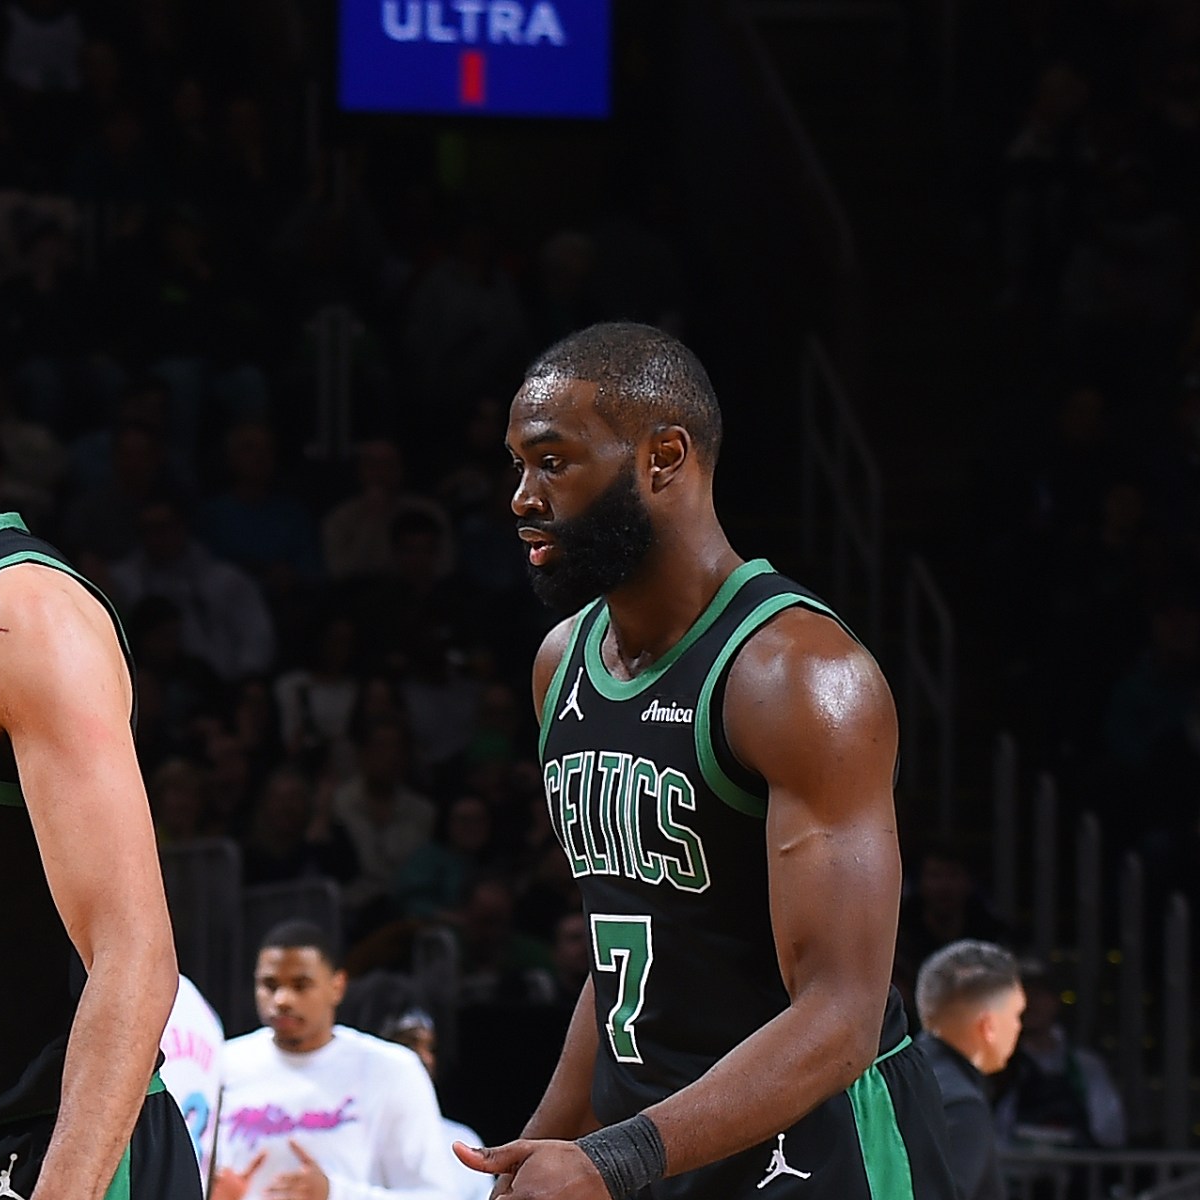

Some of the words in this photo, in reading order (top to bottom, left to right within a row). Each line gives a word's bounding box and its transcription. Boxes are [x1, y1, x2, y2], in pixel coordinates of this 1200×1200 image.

[381, 0, 566, 45] ULTRA
[641, 699, 693, 724] Amica
[590, 913, 653, 1065] 7
